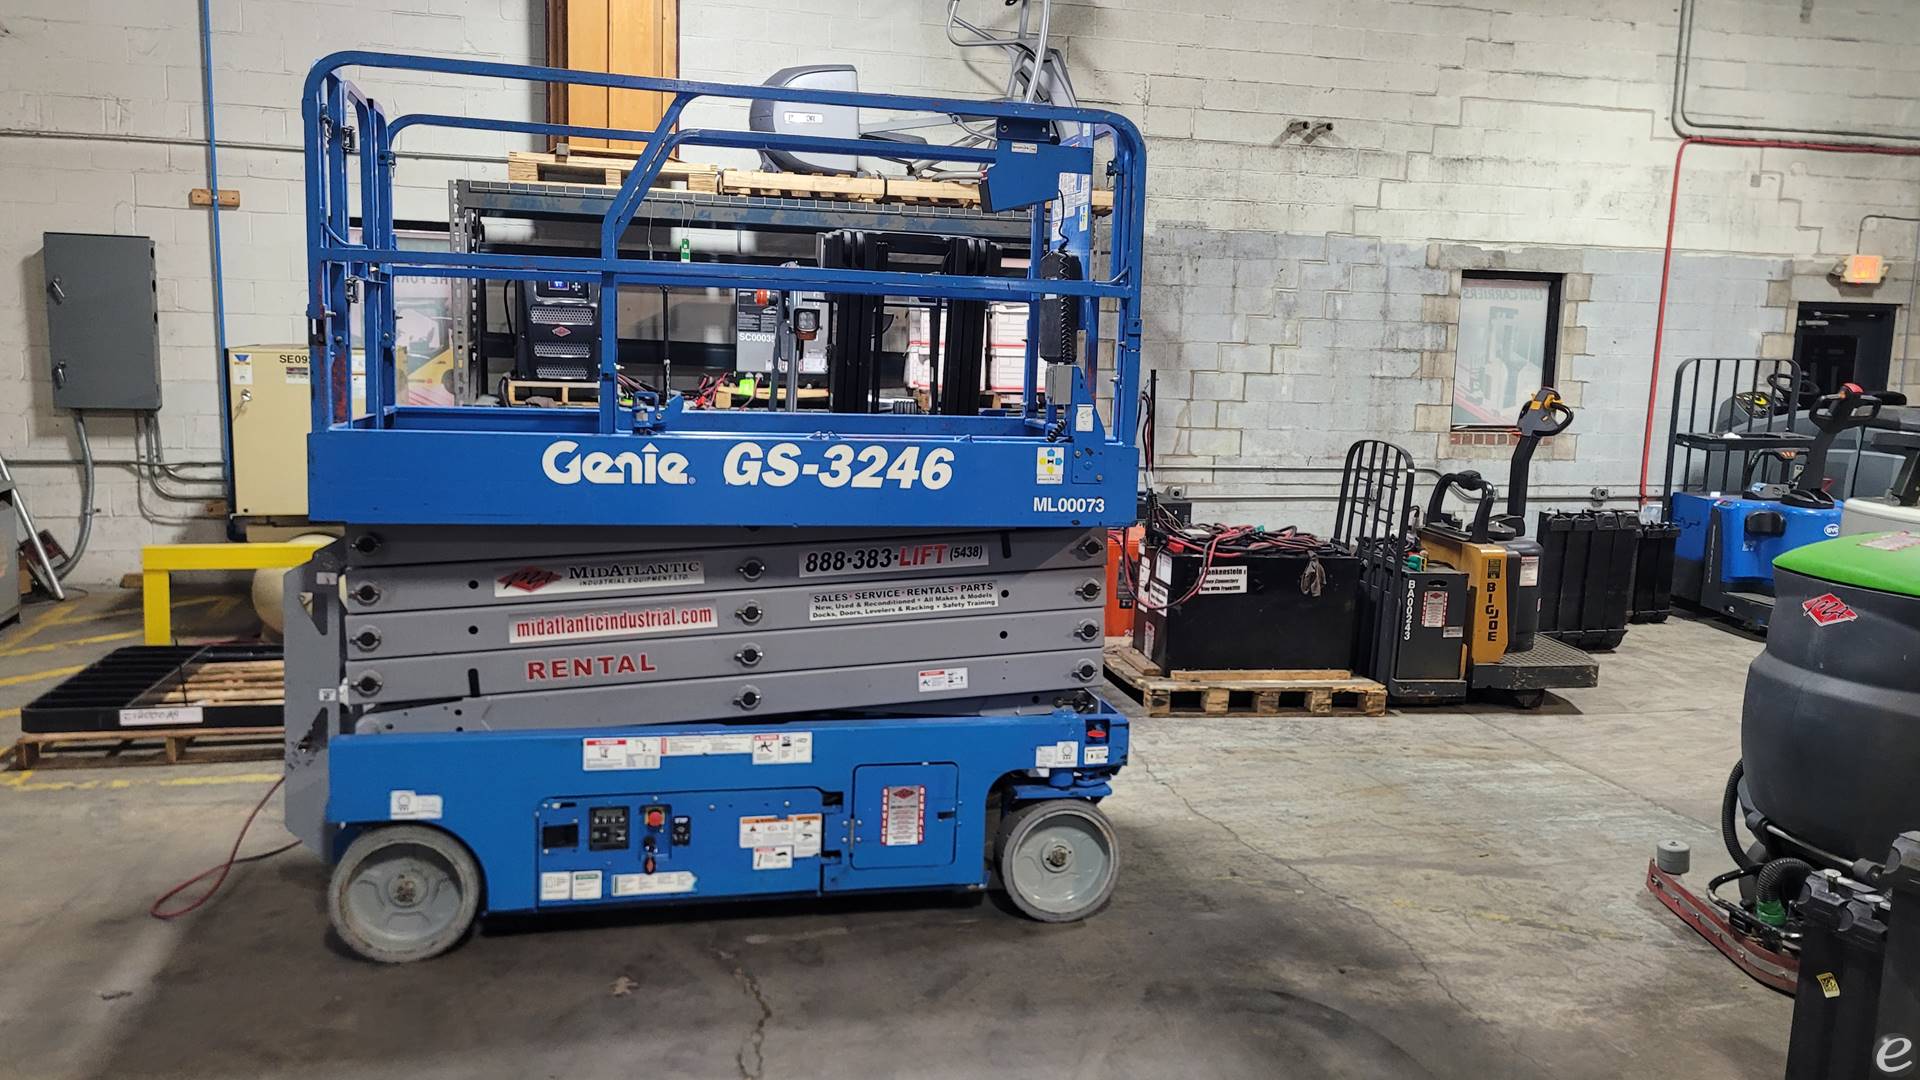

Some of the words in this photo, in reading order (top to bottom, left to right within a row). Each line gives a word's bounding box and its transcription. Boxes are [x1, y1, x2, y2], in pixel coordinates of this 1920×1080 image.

[279, 354, 312, 364] SE09
[541, 440, 688, 485] Genie
[722, 441, 955, 491] GS-3246
[1033, 497, 1105, 513] ML00073
[949, 545, 983, 561] (5438)
[814, 593, 848, 603] SALES
[855, 589, 901, 600] SERVICE
[907, 586, 954, 596] RENTALS
[960, 583, 993, 592] PARTS
[1403, 580, 1415, 641] BA00243
[517, 608, 712, 637] midatlanticindustrial.com
[528, 655, 656, 680] RENTAL
